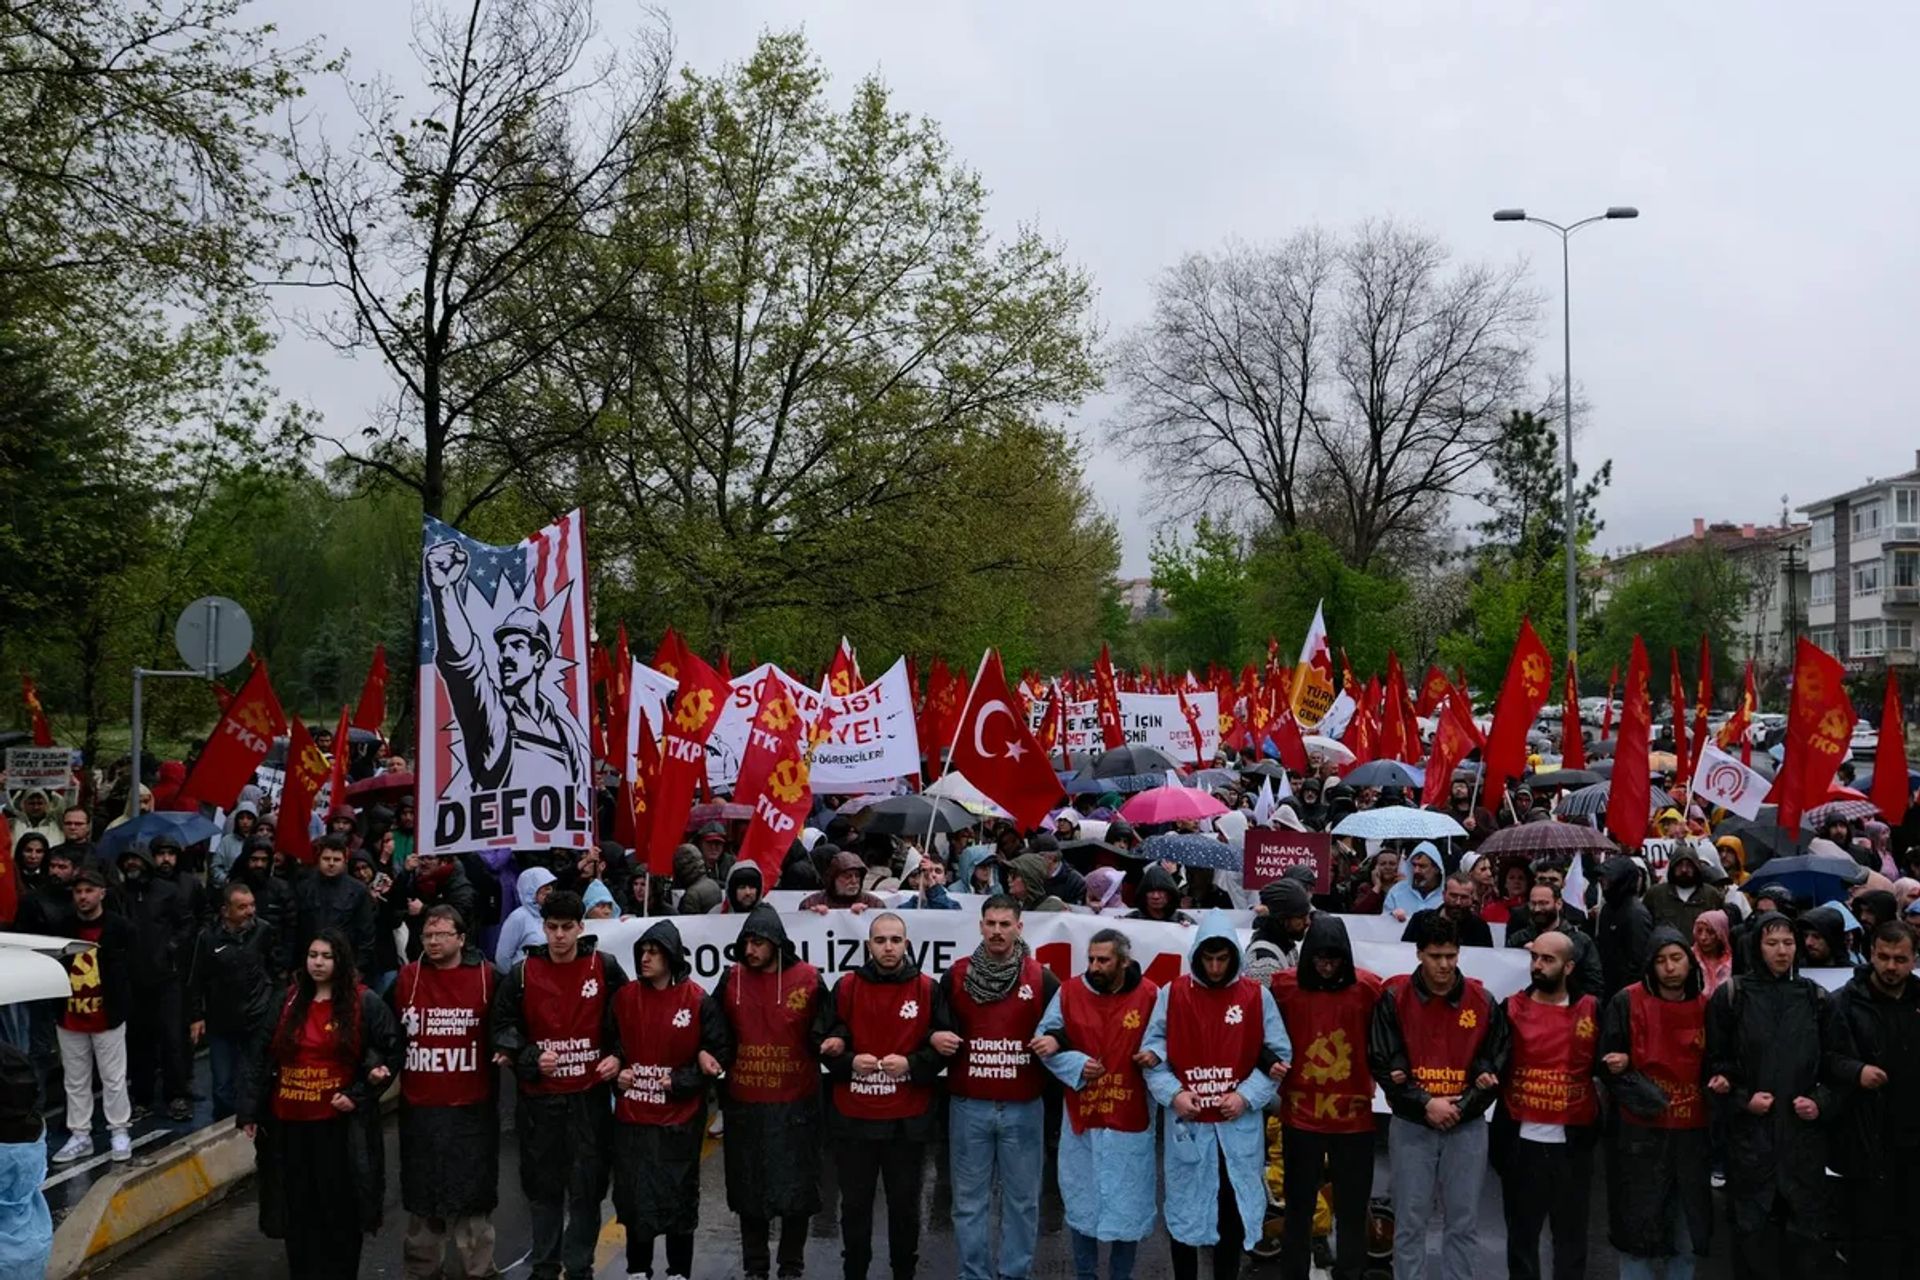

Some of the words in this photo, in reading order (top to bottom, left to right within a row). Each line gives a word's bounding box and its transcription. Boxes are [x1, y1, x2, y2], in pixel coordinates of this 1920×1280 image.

[226, 718, 267, 753] TKP
[751, 727, 783, 753] TK
[667, 734, 702, 764] TKP
[434, 785, 594, 848] DEFOL!
[755, 792, 795, 834] TKP
[1256, 856, 1294, 867] HAKÇA
[427, 1006, 473, 1017] TÜRKİYE
[426, 1016, 480, 1027] KOMÜNİST
[426, 1025, 467, 1036] PARTİSİ
[536, 1037, 592, 1051] TÜRKİYE
[970, 1038, 1022, 1051] TÜRKİYE
[969, 1051, 1031, 1064] KOMÜNİST
[968, 1065, 1017, 1079] PARTİSİ
[1184, 1066, 1233, 1080] TÜRKİYE
[850, 1081, 896, 1096] PARTİSİ
